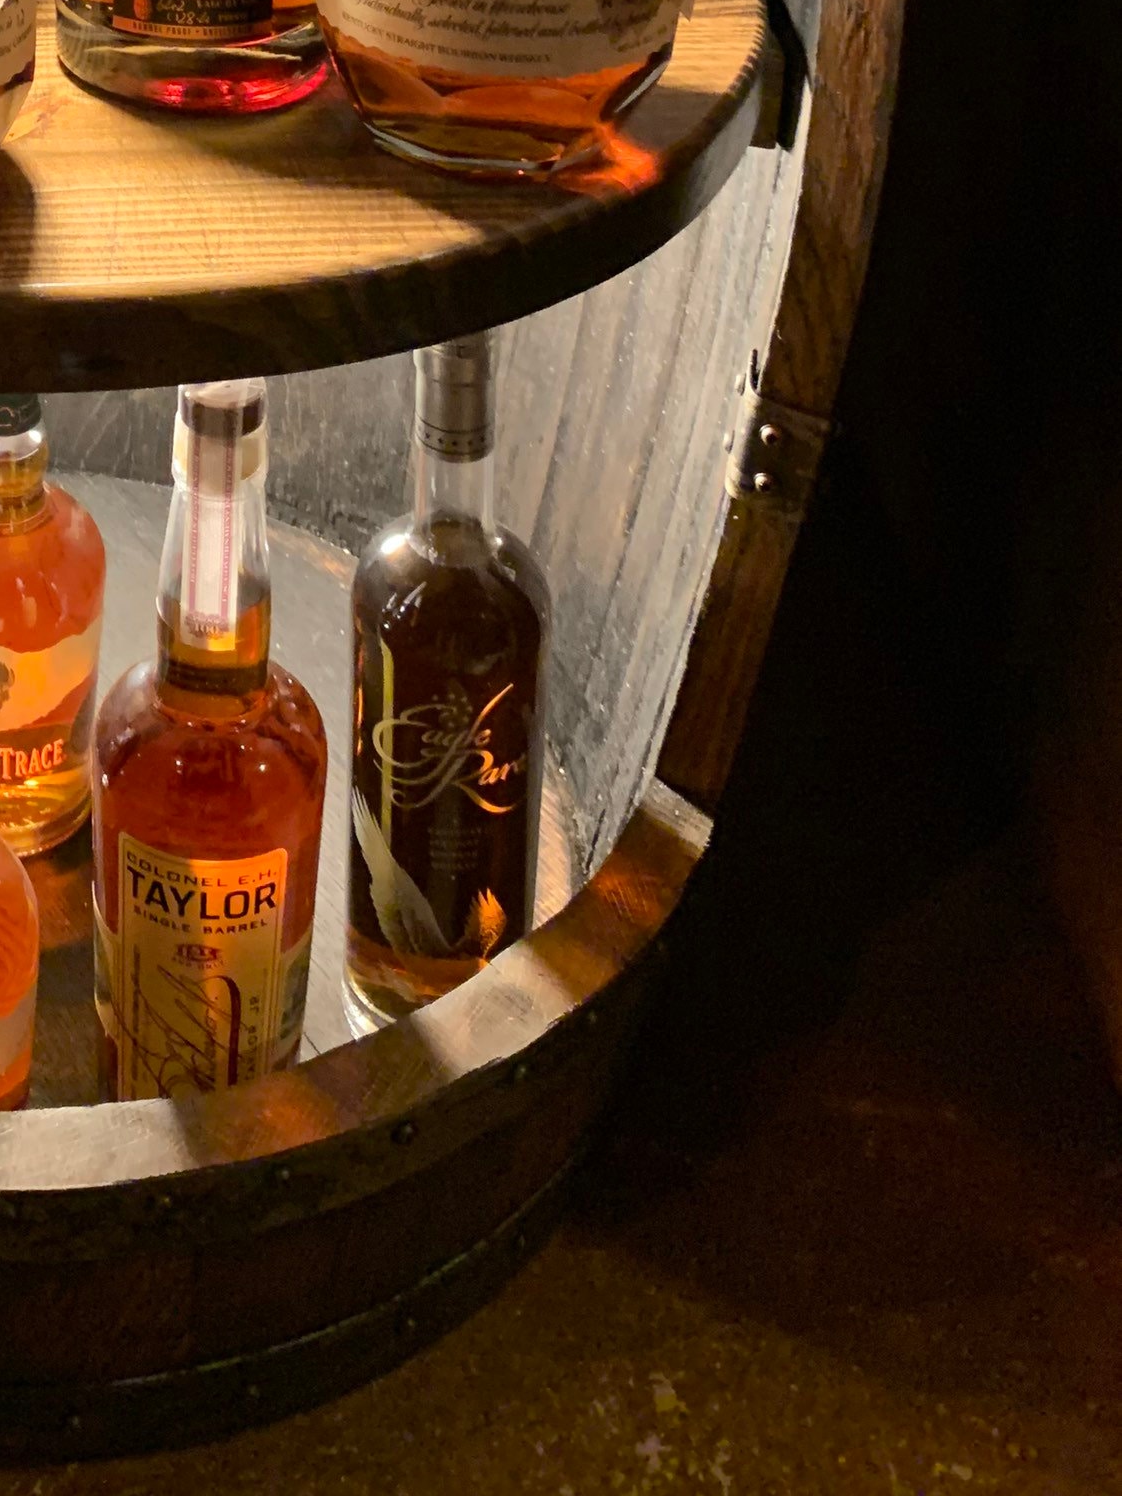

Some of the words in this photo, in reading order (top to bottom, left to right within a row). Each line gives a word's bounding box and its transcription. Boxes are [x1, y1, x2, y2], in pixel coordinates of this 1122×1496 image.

[372, 682, 514, 785] Eagle
[126, 850, 228, 887] COLONEL
[238, 868, 277, 886] E.H.
[126, 865, 277, 920] TAYLOR
[133, 904, 191, 933] SINGLE
[203, 917, 268, 935] BARREL
